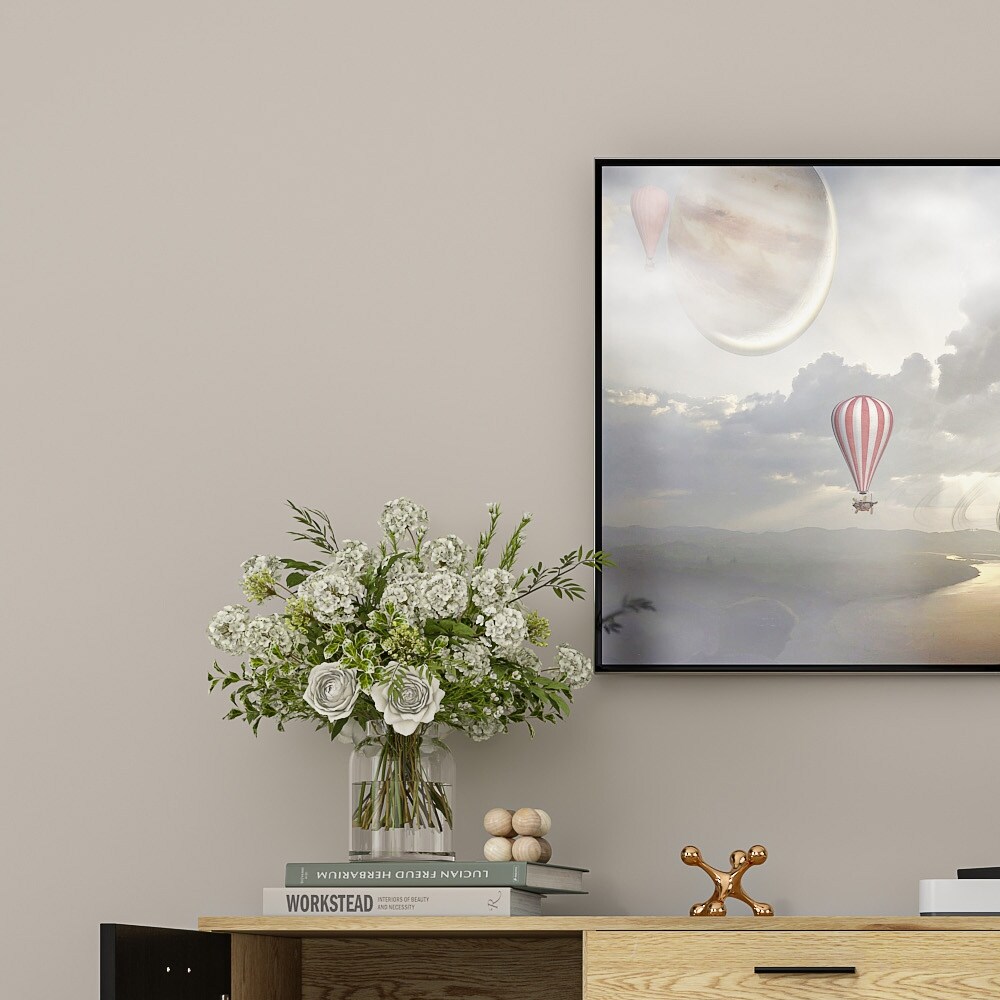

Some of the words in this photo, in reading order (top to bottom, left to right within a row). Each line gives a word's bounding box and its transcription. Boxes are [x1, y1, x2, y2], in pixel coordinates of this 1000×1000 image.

[316, 870, 392, 880] HERBARIUM
[395, 870, 437, 879] FREUD
[440, 869, 489, 879] LUCIAN
[286, 894, 374, 912] WORKSTEAD
